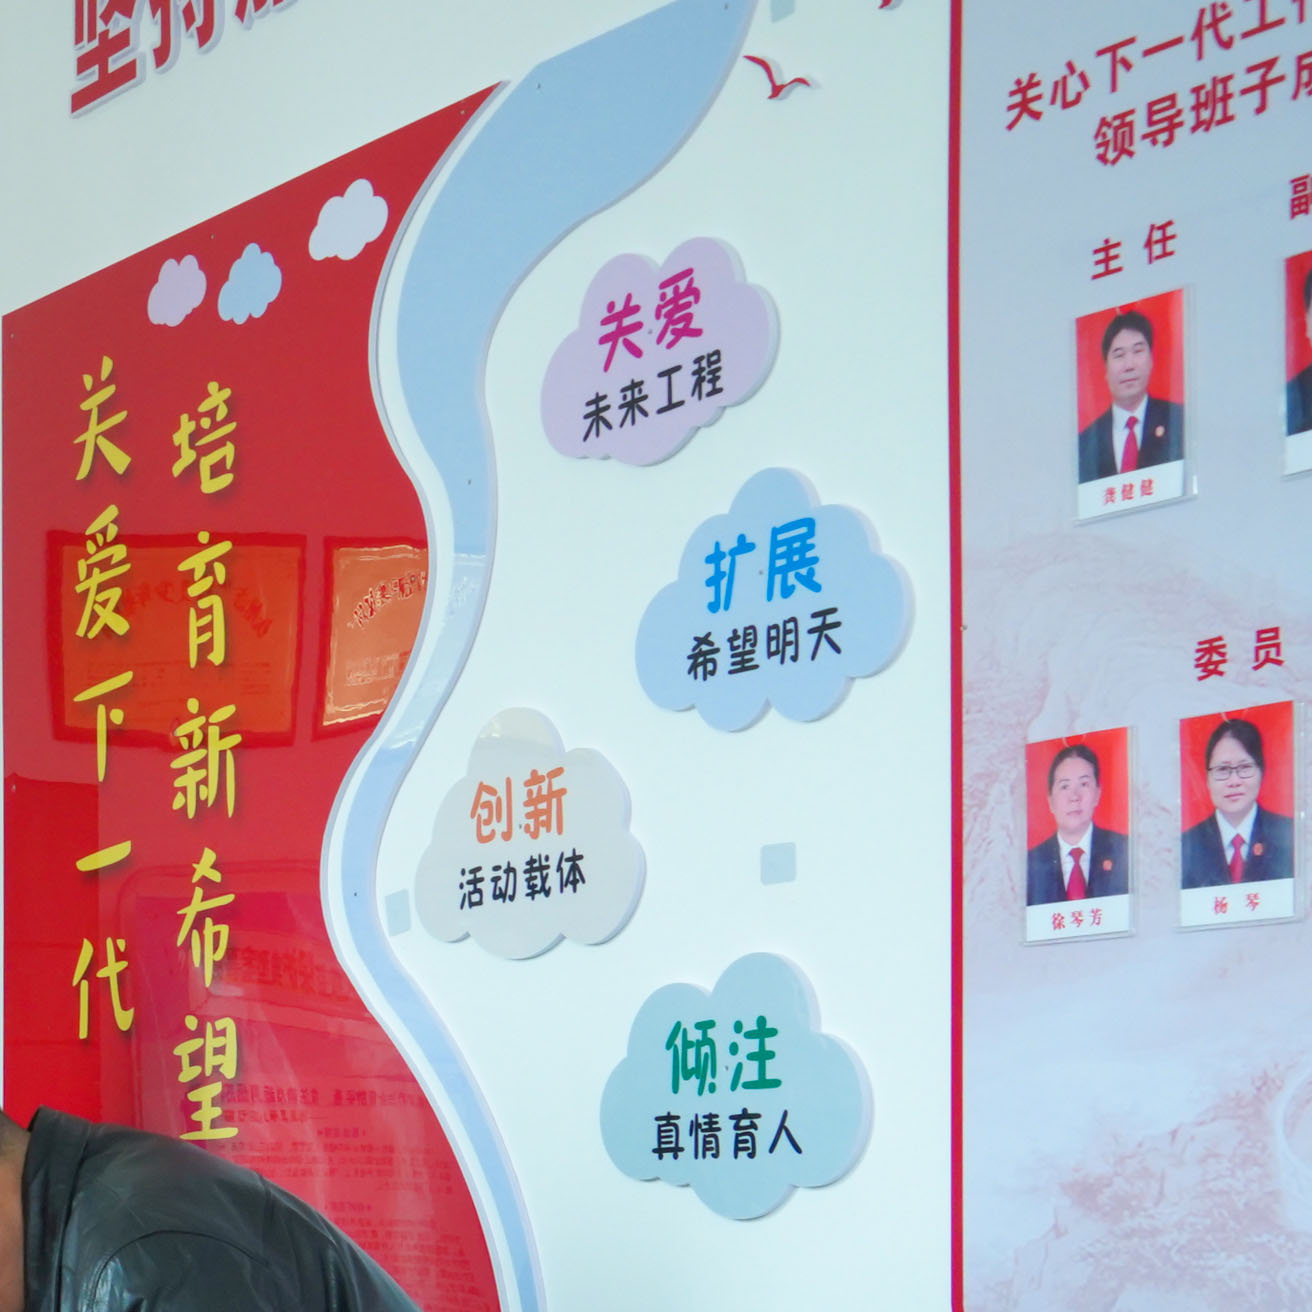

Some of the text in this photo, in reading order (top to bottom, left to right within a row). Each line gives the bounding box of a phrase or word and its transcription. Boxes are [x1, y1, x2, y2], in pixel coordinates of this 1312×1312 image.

[1091, 219, 1178, 281] 主任
[598, 267, 704, 373] 关爱
[582, 348, 724, 442] 未来工程
[704, 517, 823, 614] 扩展
[685, 607, 844, 687] 希望明天
[1194, 626, 1286, 683] 委员
[71, 355, 136, 1041] 关爱下一代
[171, 381, 239, 1141] 培育新希望
[470, 765, 568, 845] 创新
[457, 848, 586, 912] 活动载体
[665, 1015, 782, 1097] 倾注
[651, 1105, 803, 1163] 真情育人
